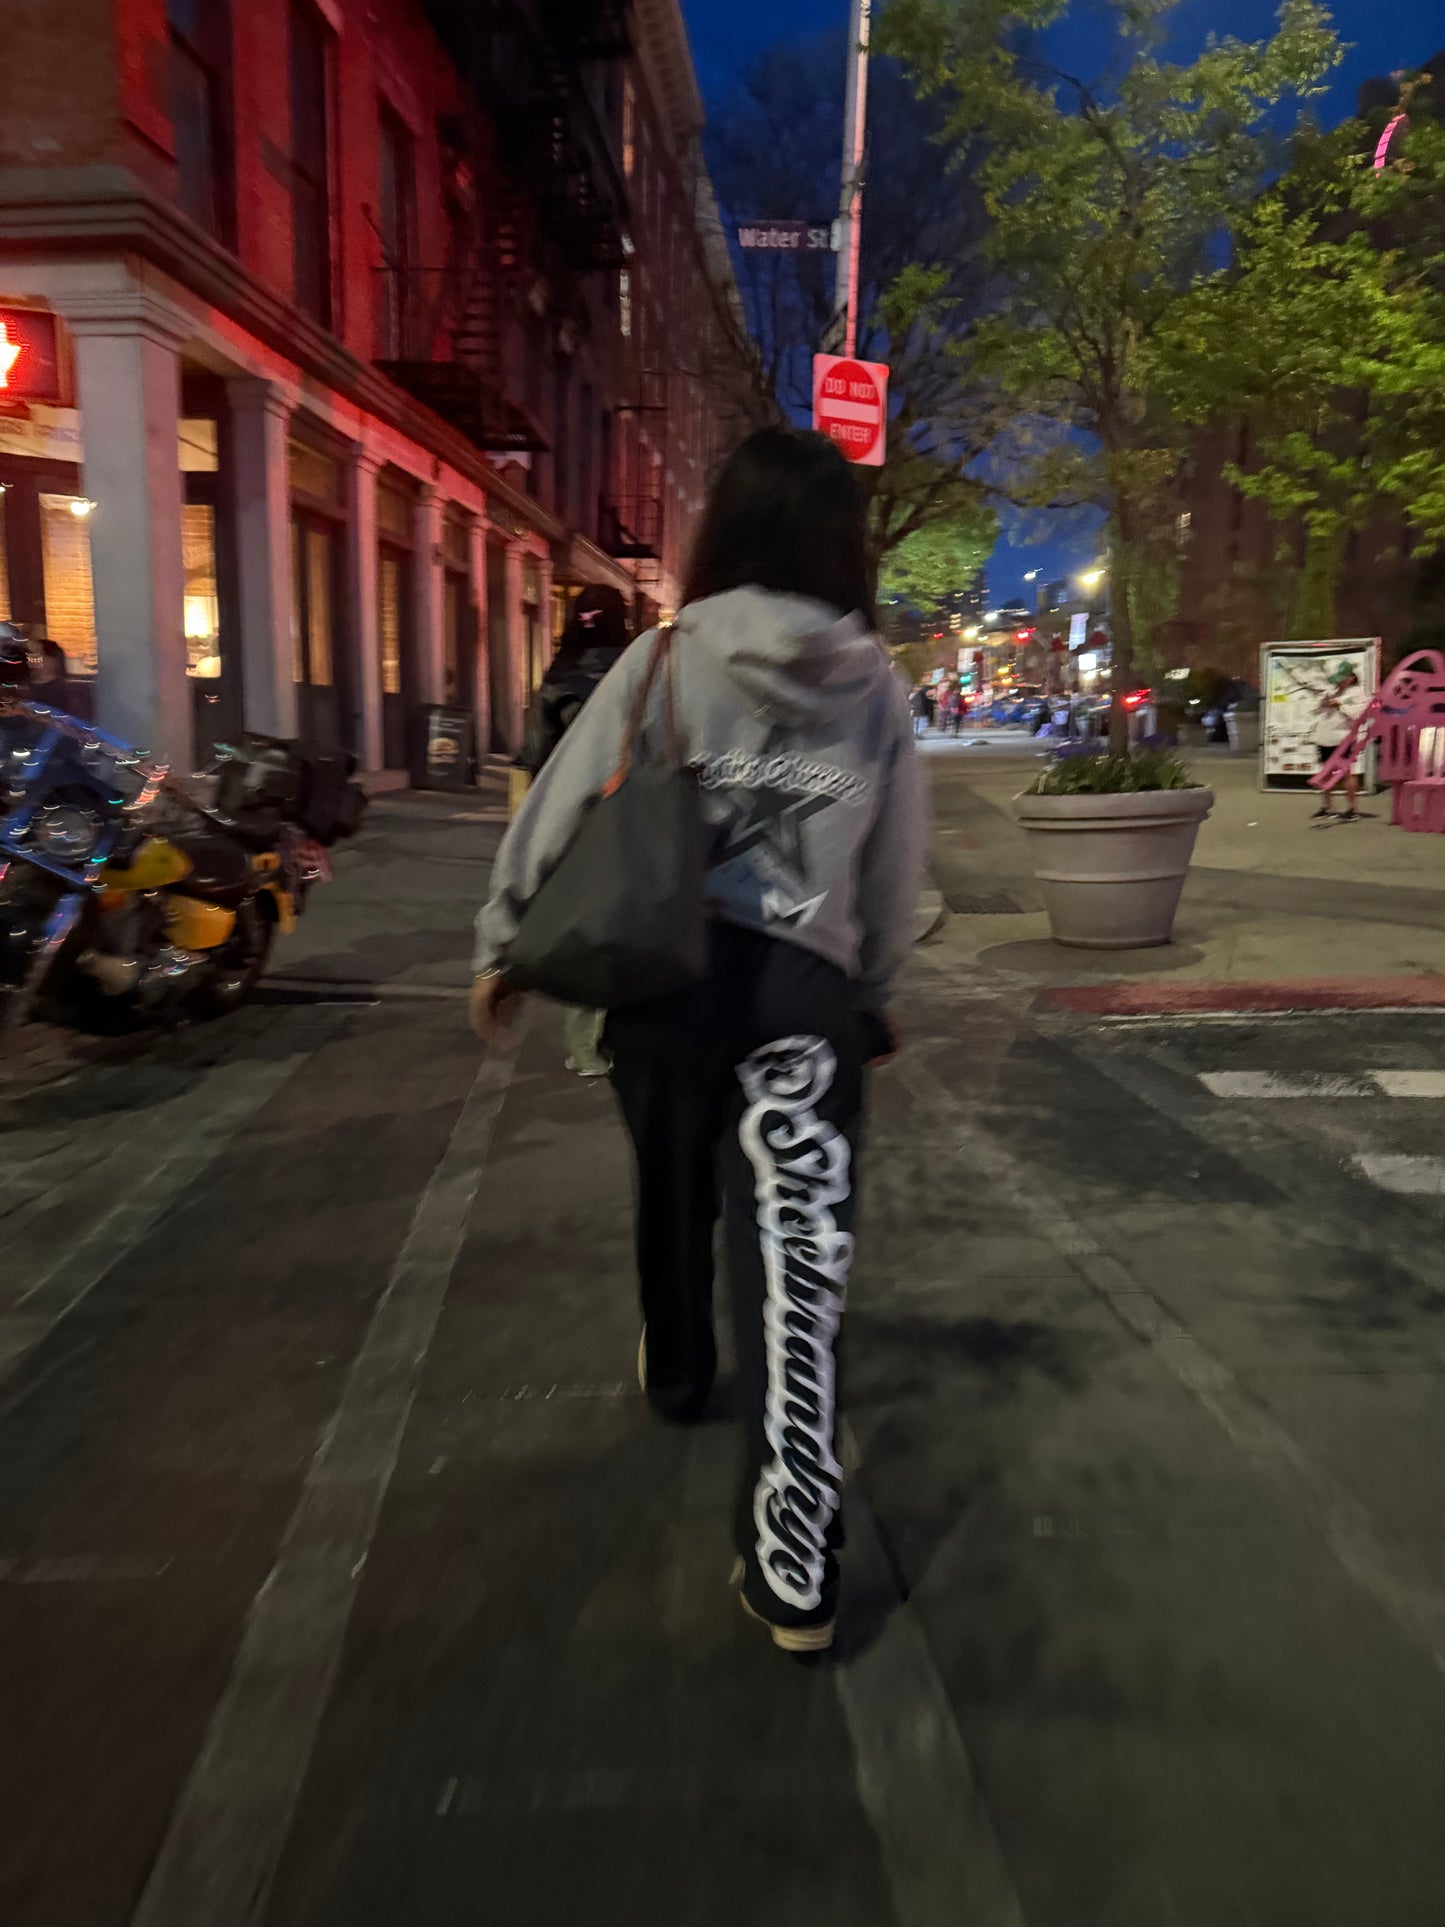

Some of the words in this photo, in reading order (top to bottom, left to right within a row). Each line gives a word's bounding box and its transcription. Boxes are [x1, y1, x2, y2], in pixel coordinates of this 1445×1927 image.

[738, 227, 800, 248] Water
[807, 228, 830, 249] St
[825, 377, 847, 395] DO
[849, 380, 876, 399] NOT
[830, 422, 872, 444] ENTER
